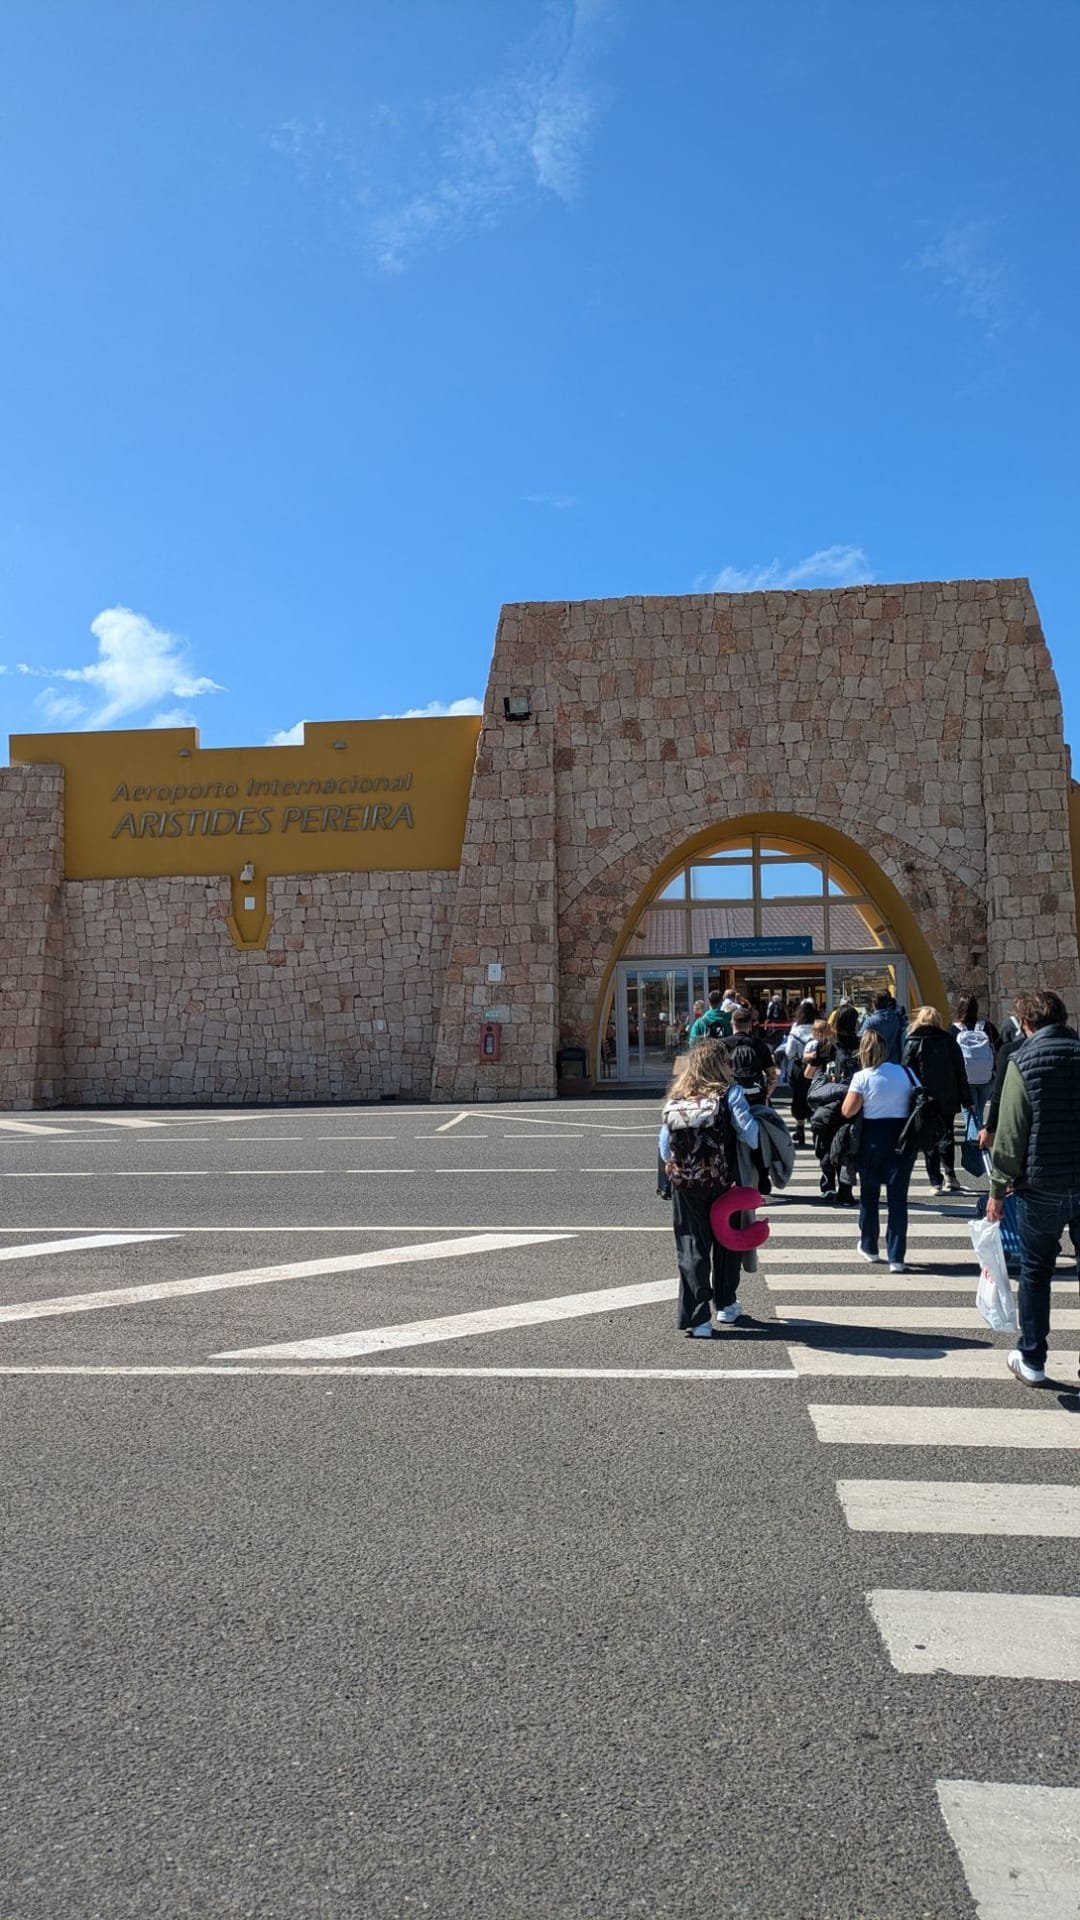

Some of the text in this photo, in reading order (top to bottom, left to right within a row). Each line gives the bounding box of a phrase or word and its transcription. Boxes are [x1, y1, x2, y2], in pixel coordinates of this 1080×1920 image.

[112, 773, 413, 804] Aeroporto Internacional
[111, 802, 415, 839] ARISTIDES PEREIRA
